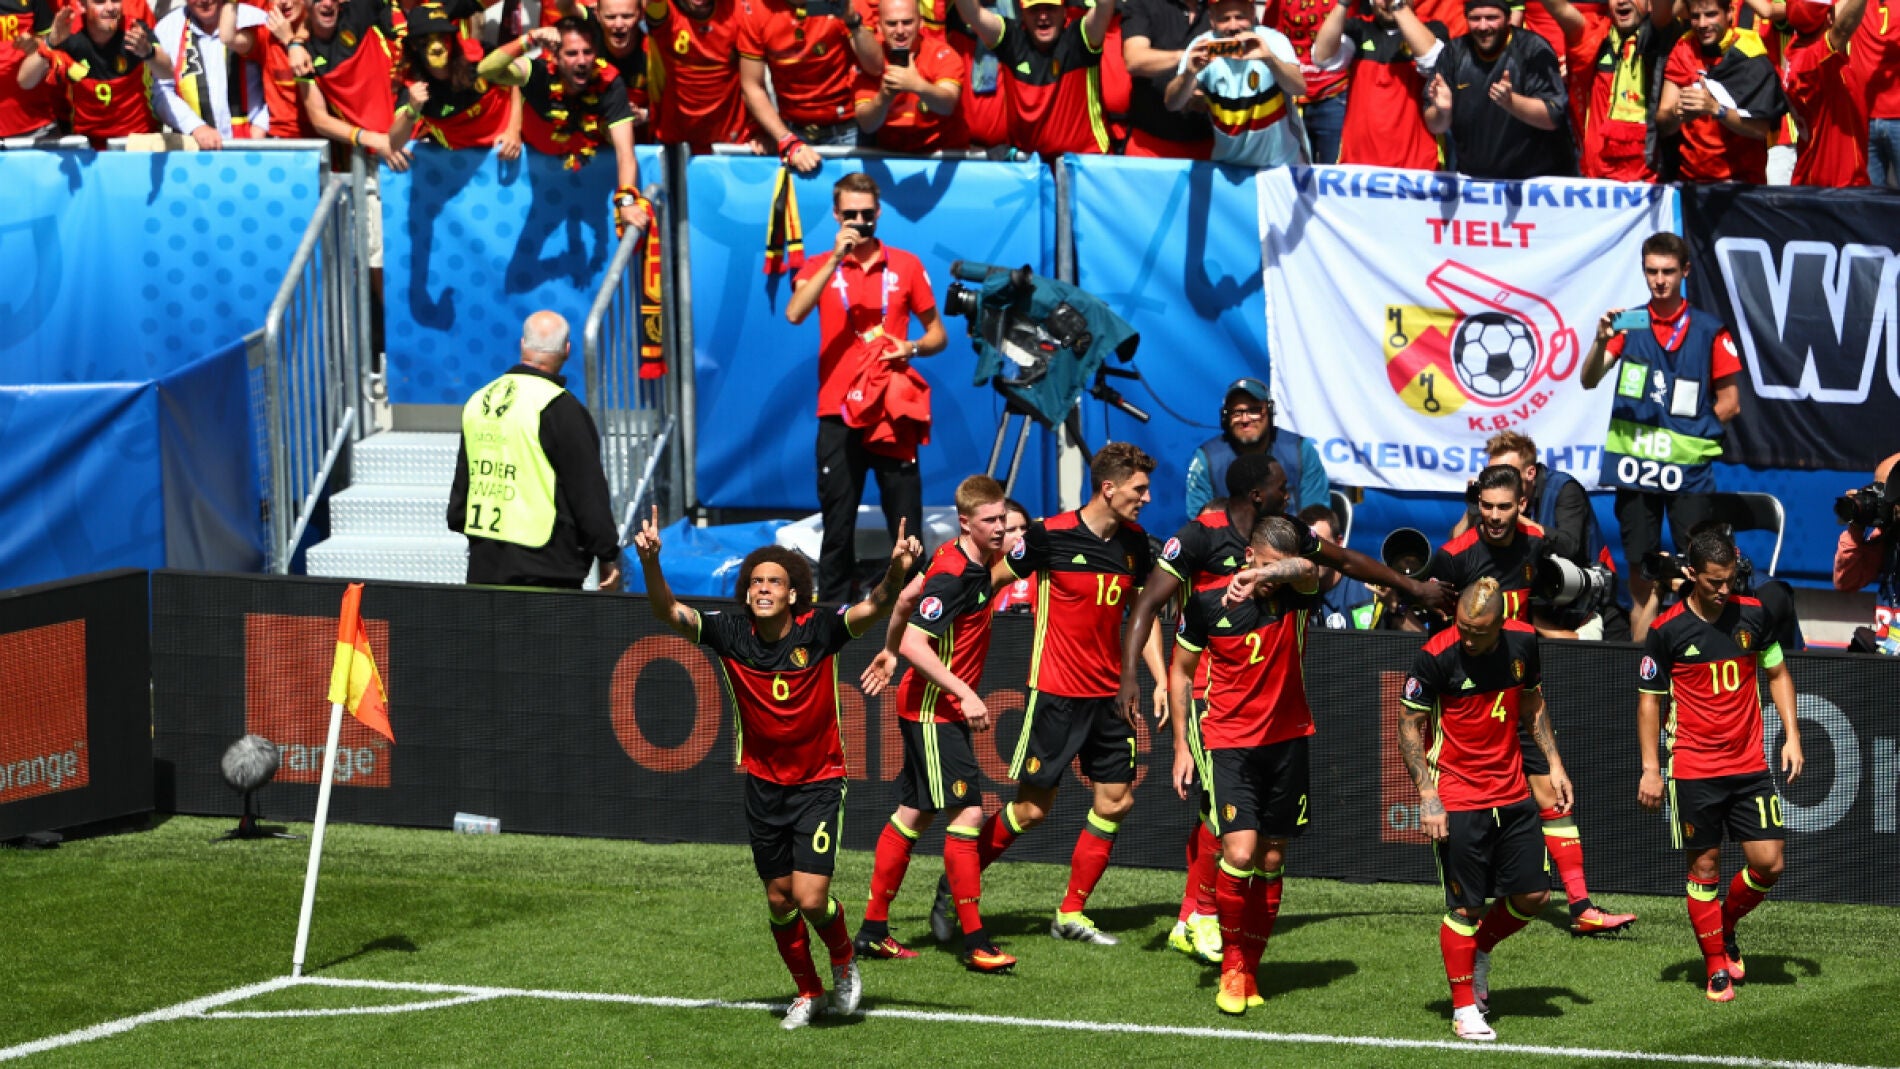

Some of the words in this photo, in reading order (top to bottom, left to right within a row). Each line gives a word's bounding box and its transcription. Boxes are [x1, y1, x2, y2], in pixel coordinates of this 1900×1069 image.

[1878, 7, 1888, 35] 7
[674, 30, 690, 54] 8
[95, 83, 111, 106] 9
[1425, 217, 1536, 248] TIELT
[1714, 236, 1900, 404] W
[1468, 391, 1554, 432] K.B.V.B.
[1633, 428, 1672, 458] HB
[1617, 456, 1683, 491] 020
[1096, 574, 1121, 605] 16
[1503, 591, 1519, 621] 11
[1246, 632, 1264, 664] 2
[772, 672, 790, 701] 6
[1710, 660, 1738, 695] 10
[1491, 692, 1506, 722] 4
[276, 743, 375, 782] range
[1127, 737, 1136, 769] 1
[1297, 793, 1308, 825] 2
[1755, 794, 1783, 829] 10
[812, 821, 830, 853] 6
